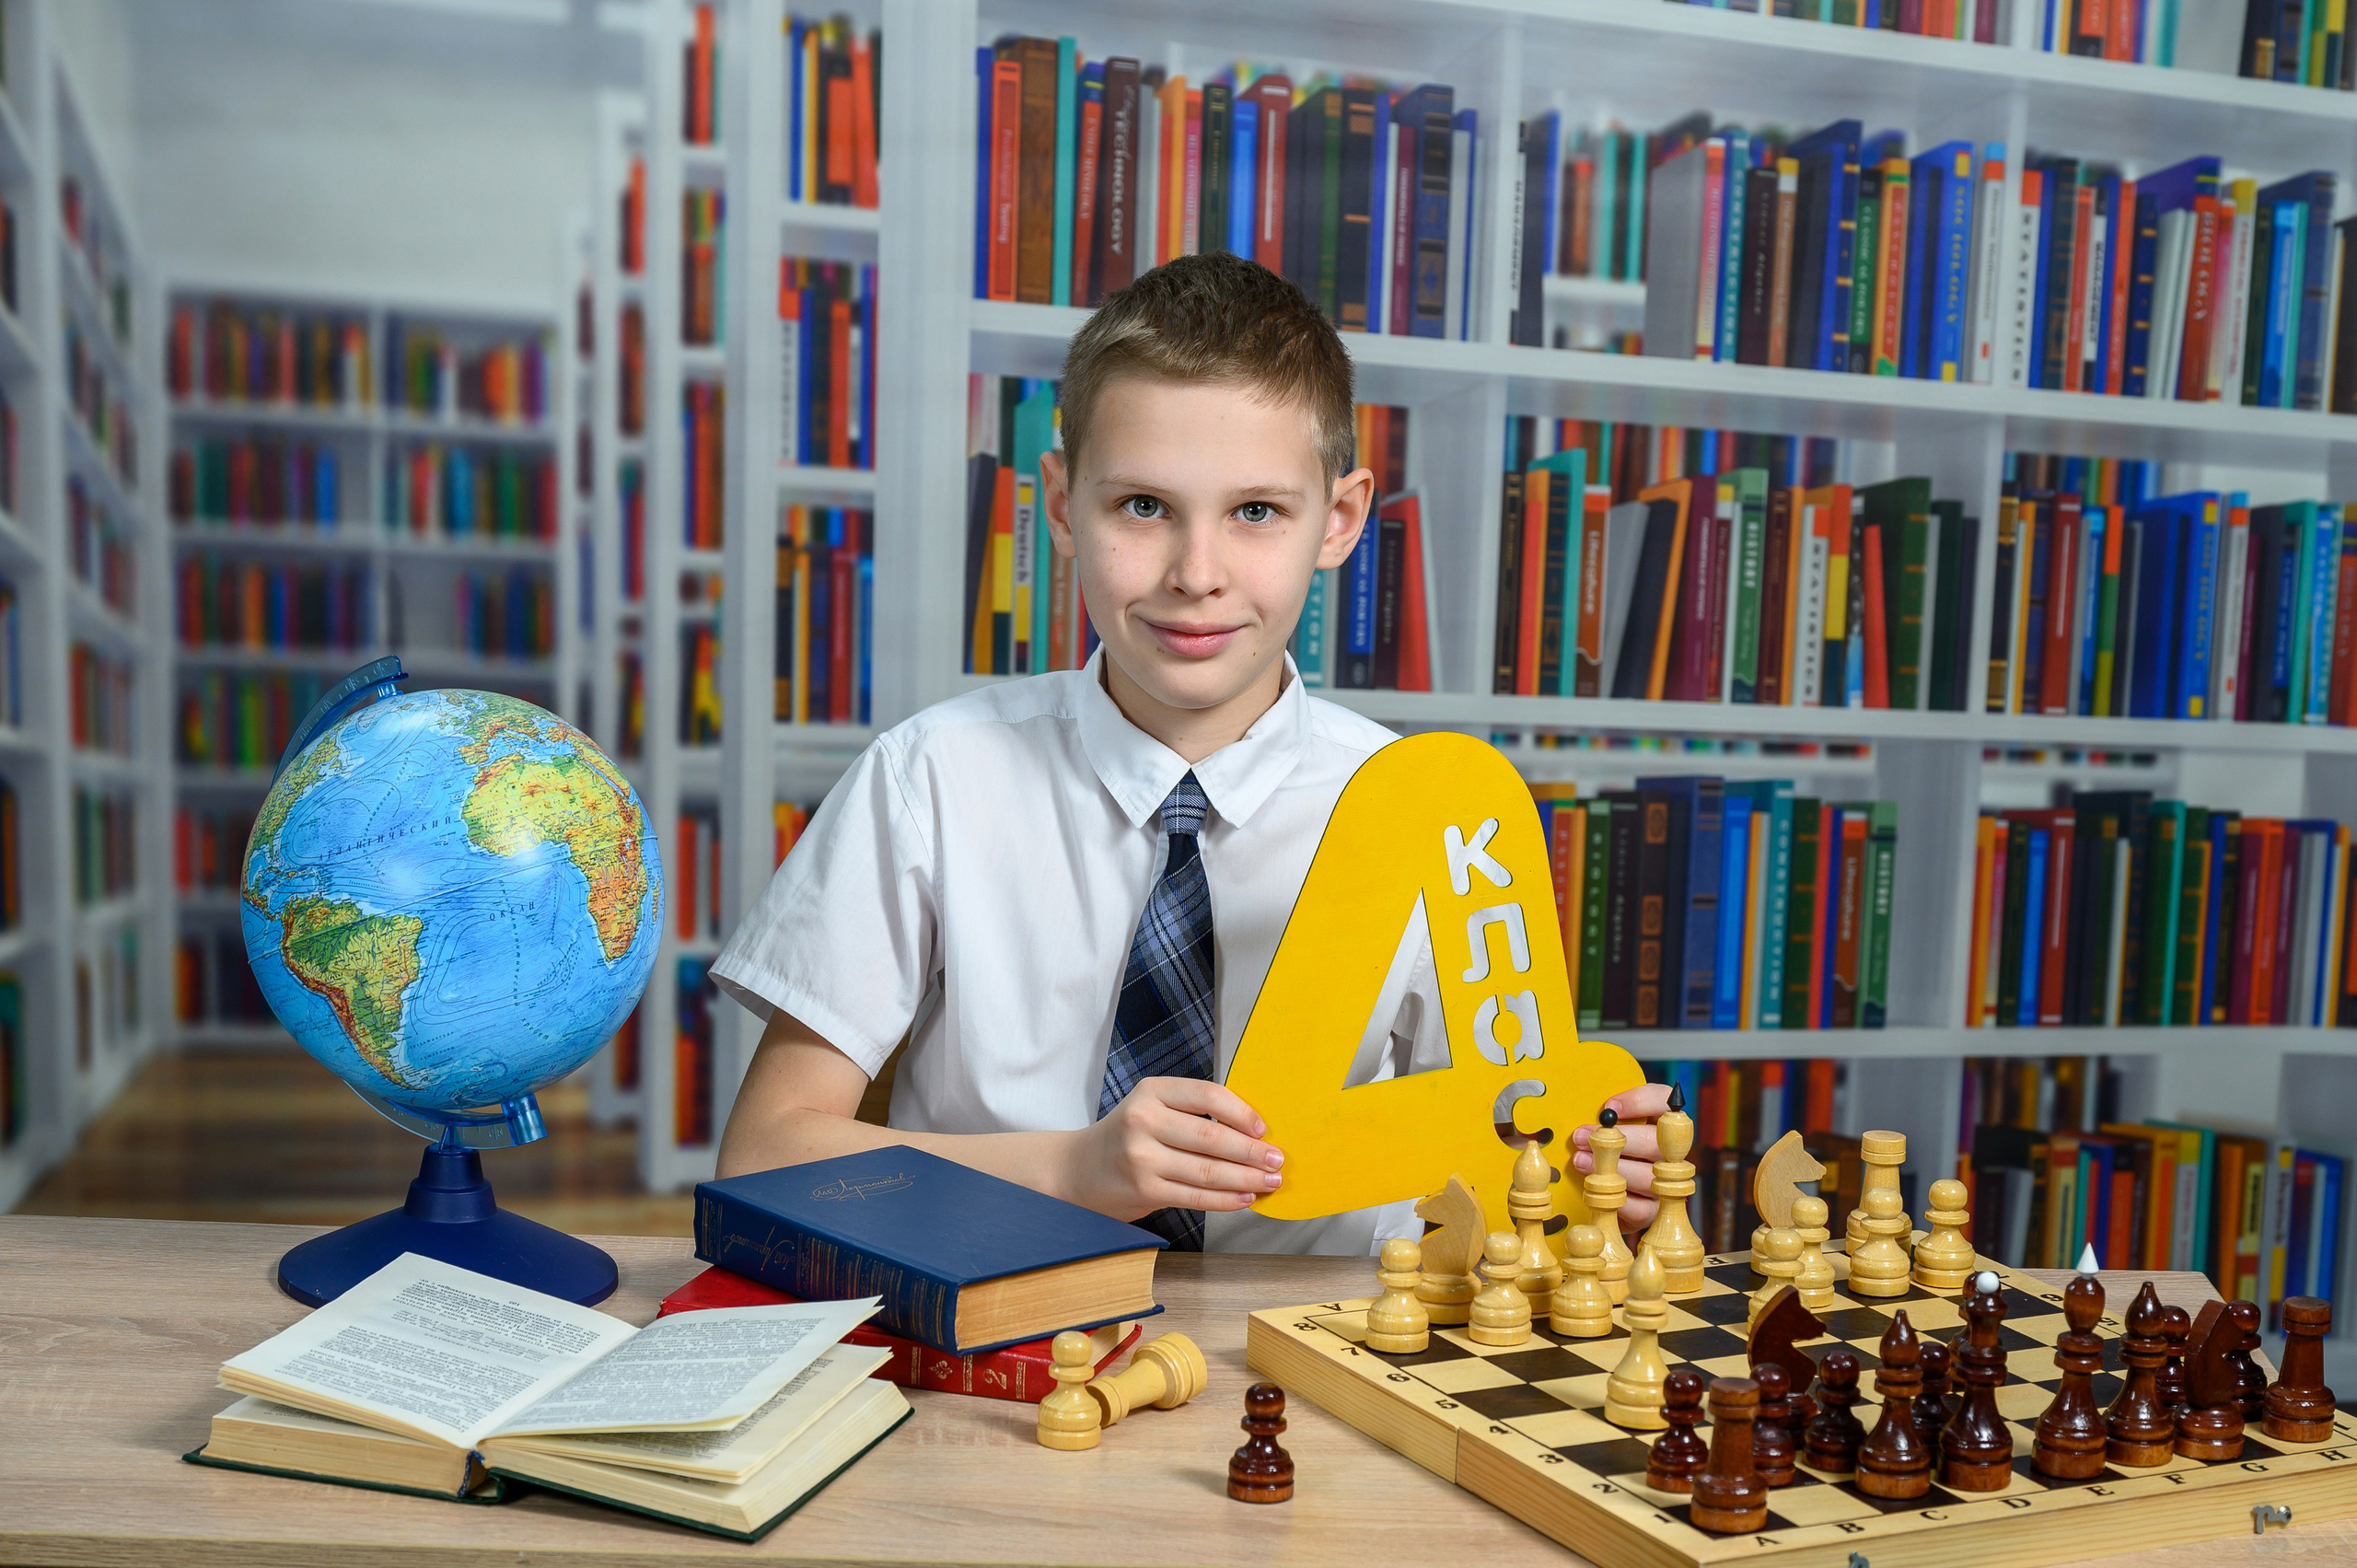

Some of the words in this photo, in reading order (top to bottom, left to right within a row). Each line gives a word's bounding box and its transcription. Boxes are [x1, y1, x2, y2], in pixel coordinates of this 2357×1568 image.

[1110, 109, 1127, 256] TECHNOLOGY
[1724, 168, 1746, 347] CONSTRUCTION
[1753, 251, 1767, 316] Algebra
[2011, 211, 2033, 382] STATISTICS
[1016, 507, 1032, 585] Deutsch
[1584, 529, 1601, 616] Literature
[1744, 521, 1759, 590] HISTORY
[1804, 542, 1823, 697] STATISTICS
[319, 816, 452, 862] АТЛАНТИЧЕСКИЙ
[1587, 830, 1603, 957] BIOLOGY
[1769, 819, 1789, 1000] CONSTRUCTION
[1841, 856, 1858, 942] Literature
[1875, 851, 1891, 916] HISTORY
[1611, 895, 1624, 964] Algebra
[1293, 1321, 1317, 1331] 8
[1322, 1301, 1342, 1311] A
[2039, 1292, 2063, 1303] 6
[982, 1368, 1007, 1390] 2
[1341, 1346, 1361, 1356] 7
[1387, 1372, 1411, 1383] 6
[1434, 1400, 1459, 1410] 5
[1489, 1425, 1512, 1435] 4
[1538, 1453, 1563, 1464] 3
[1593, 1482, 1619, 1494] 2
[1653, 1513, 1677, 1524] 1
[1755, 1536, 1780, 1548] A
[1836, 1521, 1865, 1535] B
[1920, 1509, 1948, 1521] C
[1999, 1497, 2032, 1510] D
[2085, 1484, 2116, 1497] E
[2164, 1473, 2189, 1485] F
[2241, 1461, 2269, 1473] G
[2316, 1448, 2353, 1462] H
